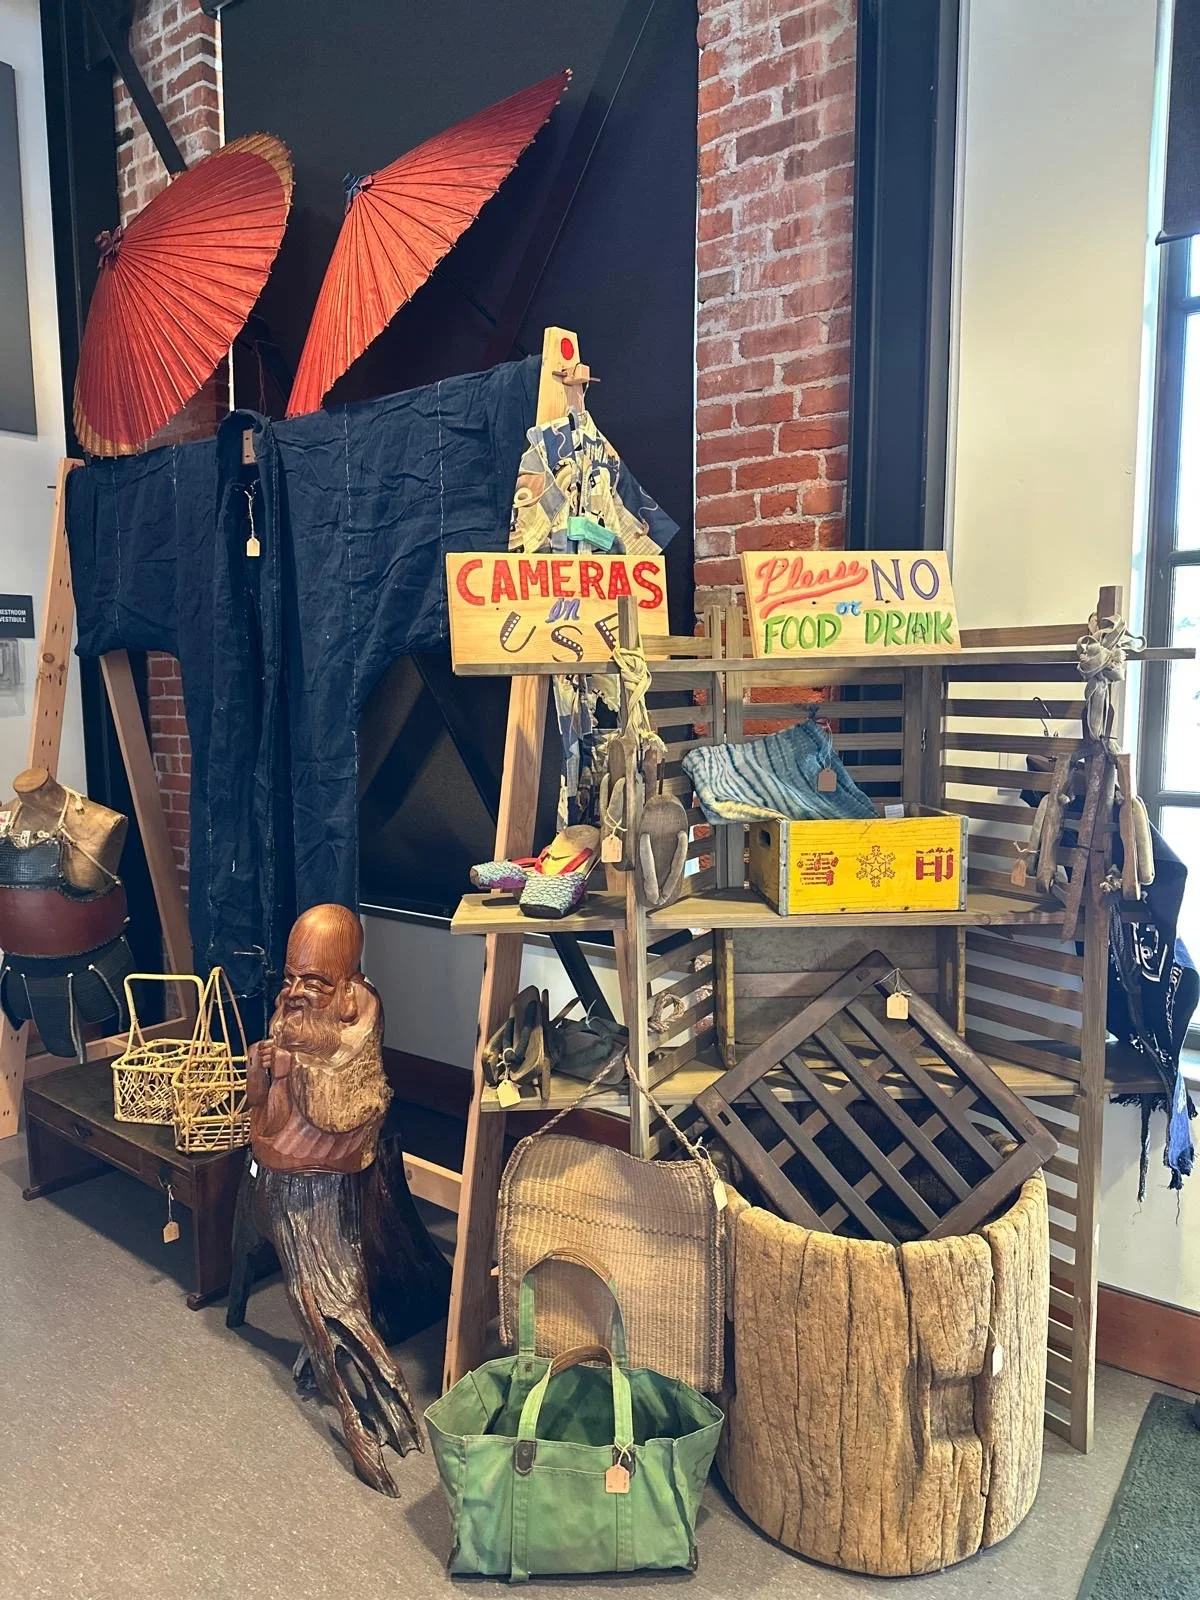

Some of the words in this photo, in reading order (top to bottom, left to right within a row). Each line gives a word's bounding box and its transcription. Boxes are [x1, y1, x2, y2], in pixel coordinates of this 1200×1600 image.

[456, 559, 664, 609] CAMERAS
[755, 556, 868, 603] Please
[871, 558, 940, 601] NO
[764, 613, 842, 654] FOOD
[864, 609, 954, 647] DRINK
